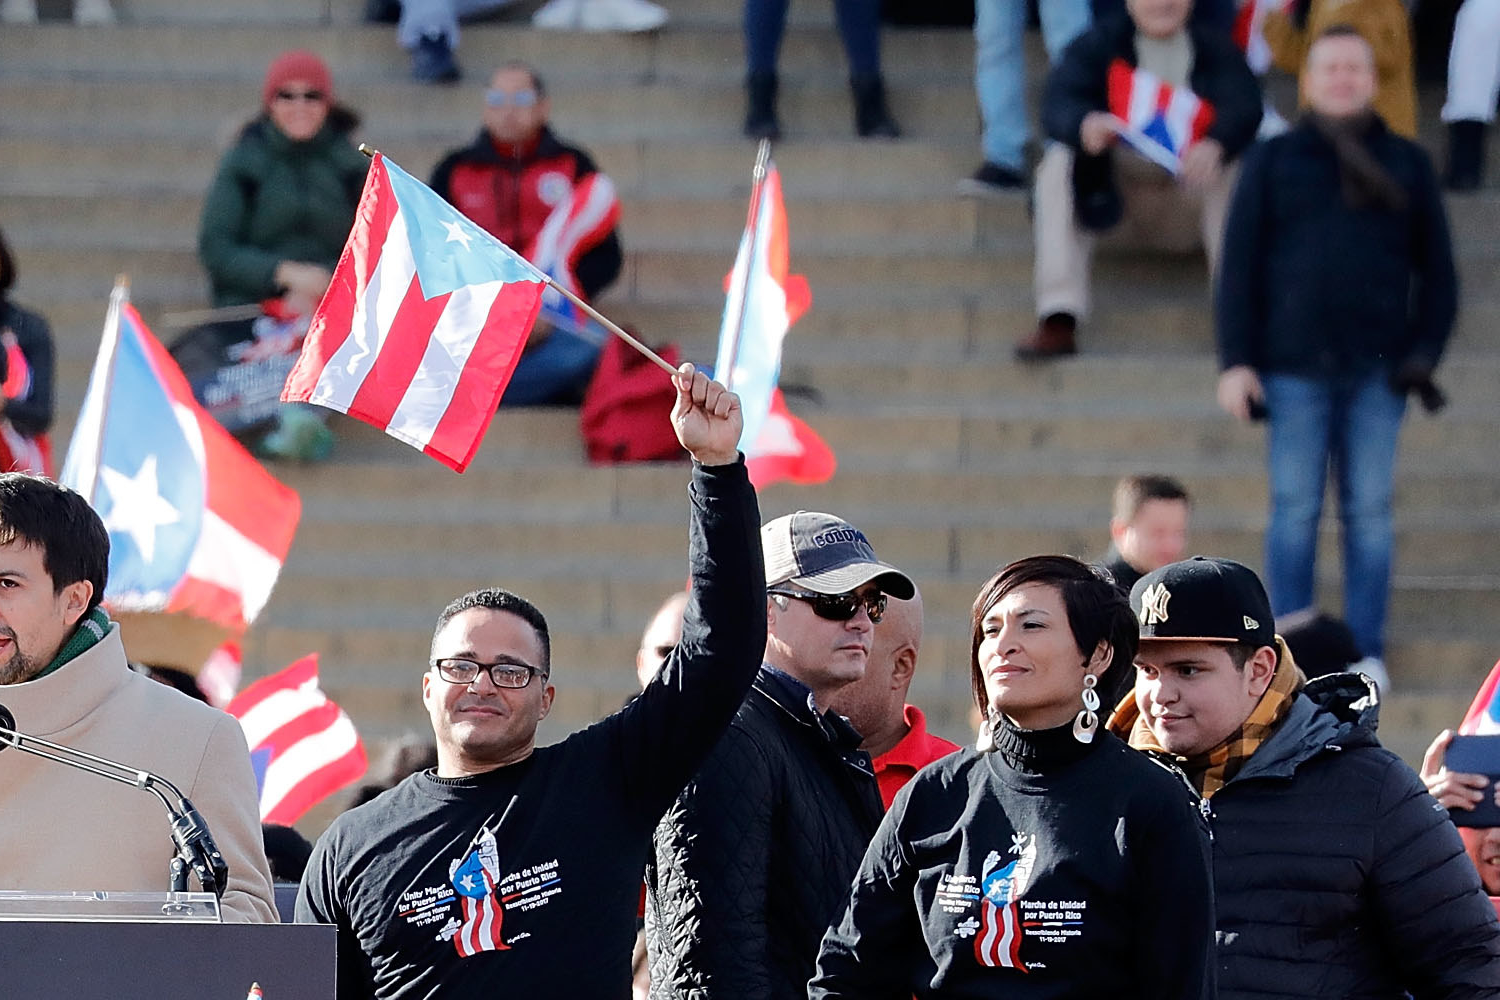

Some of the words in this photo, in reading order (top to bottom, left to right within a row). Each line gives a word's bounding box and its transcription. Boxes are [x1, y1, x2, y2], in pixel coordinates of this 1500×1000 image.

[1140, 582, 1171, 625] NY
[500, 872, 521, 886] archa
[522, 869, 532, 878] de
[532, 859, 559, 874] Unidad
[404, 891, 424, 901] Unity
[424, 883, 446, 896] Mar
[501, 885, 514, 896] por
[515, 877, 541, 890] Puerto
[540, 871, 557, 881] Rico
[964, 884, 981, 894] Rico
[399, 904, 410, 913] for
[411, 896, 437, 909] Puerto
[437, 888, 454, 899] Rico
[1020, 900, 1047, 909] Marcha
[1047, 900, 1058, 909] de
[1059, 900, 1086, 909] Unidad
[1024, 912, 1038, 920] por
[1038, 911, 1064, 920] Puerto
[1064, 911, 1082, 920] Rico
